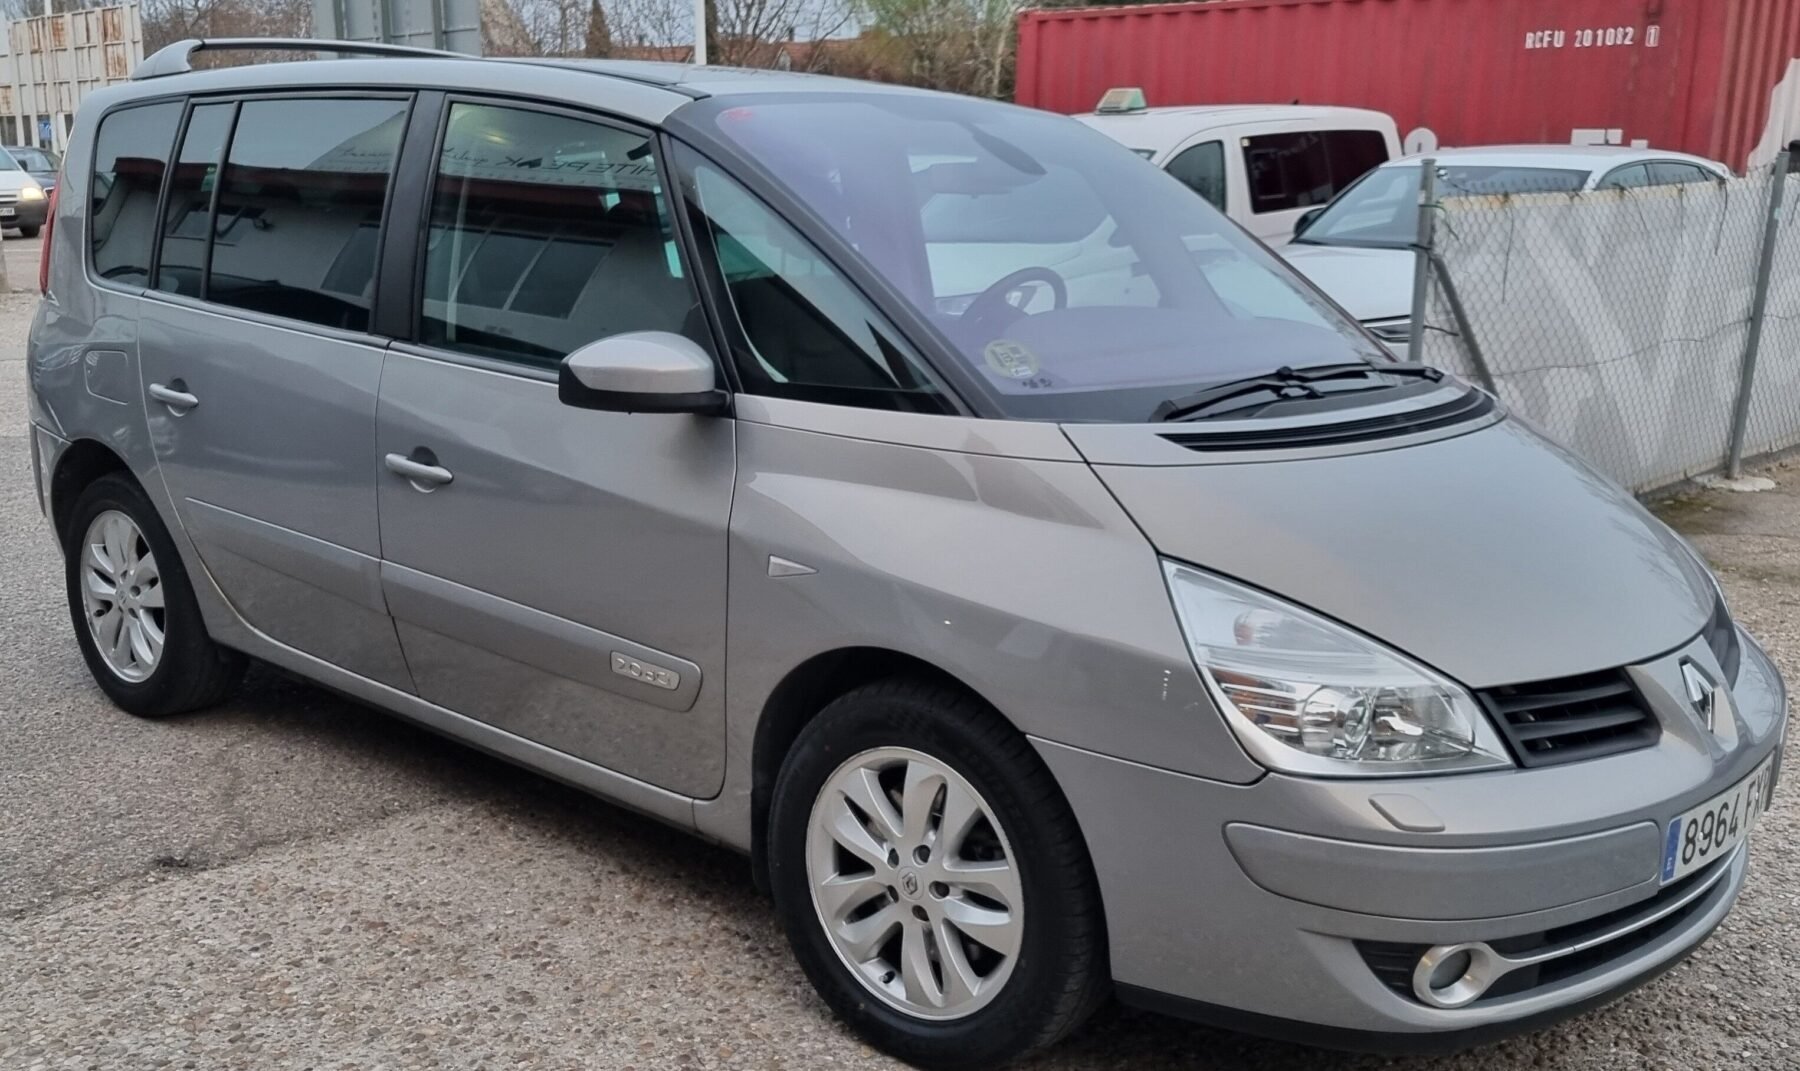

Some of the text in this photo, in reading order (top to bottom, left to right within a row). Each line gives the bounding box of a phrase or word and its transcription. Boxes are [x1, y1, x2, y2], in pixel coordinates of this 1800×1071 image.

[1525, 30, 1565, 49] RCFU
[1574, 26, 1634, 48] 201082
[1682, 792, 1741, 866] 8964
